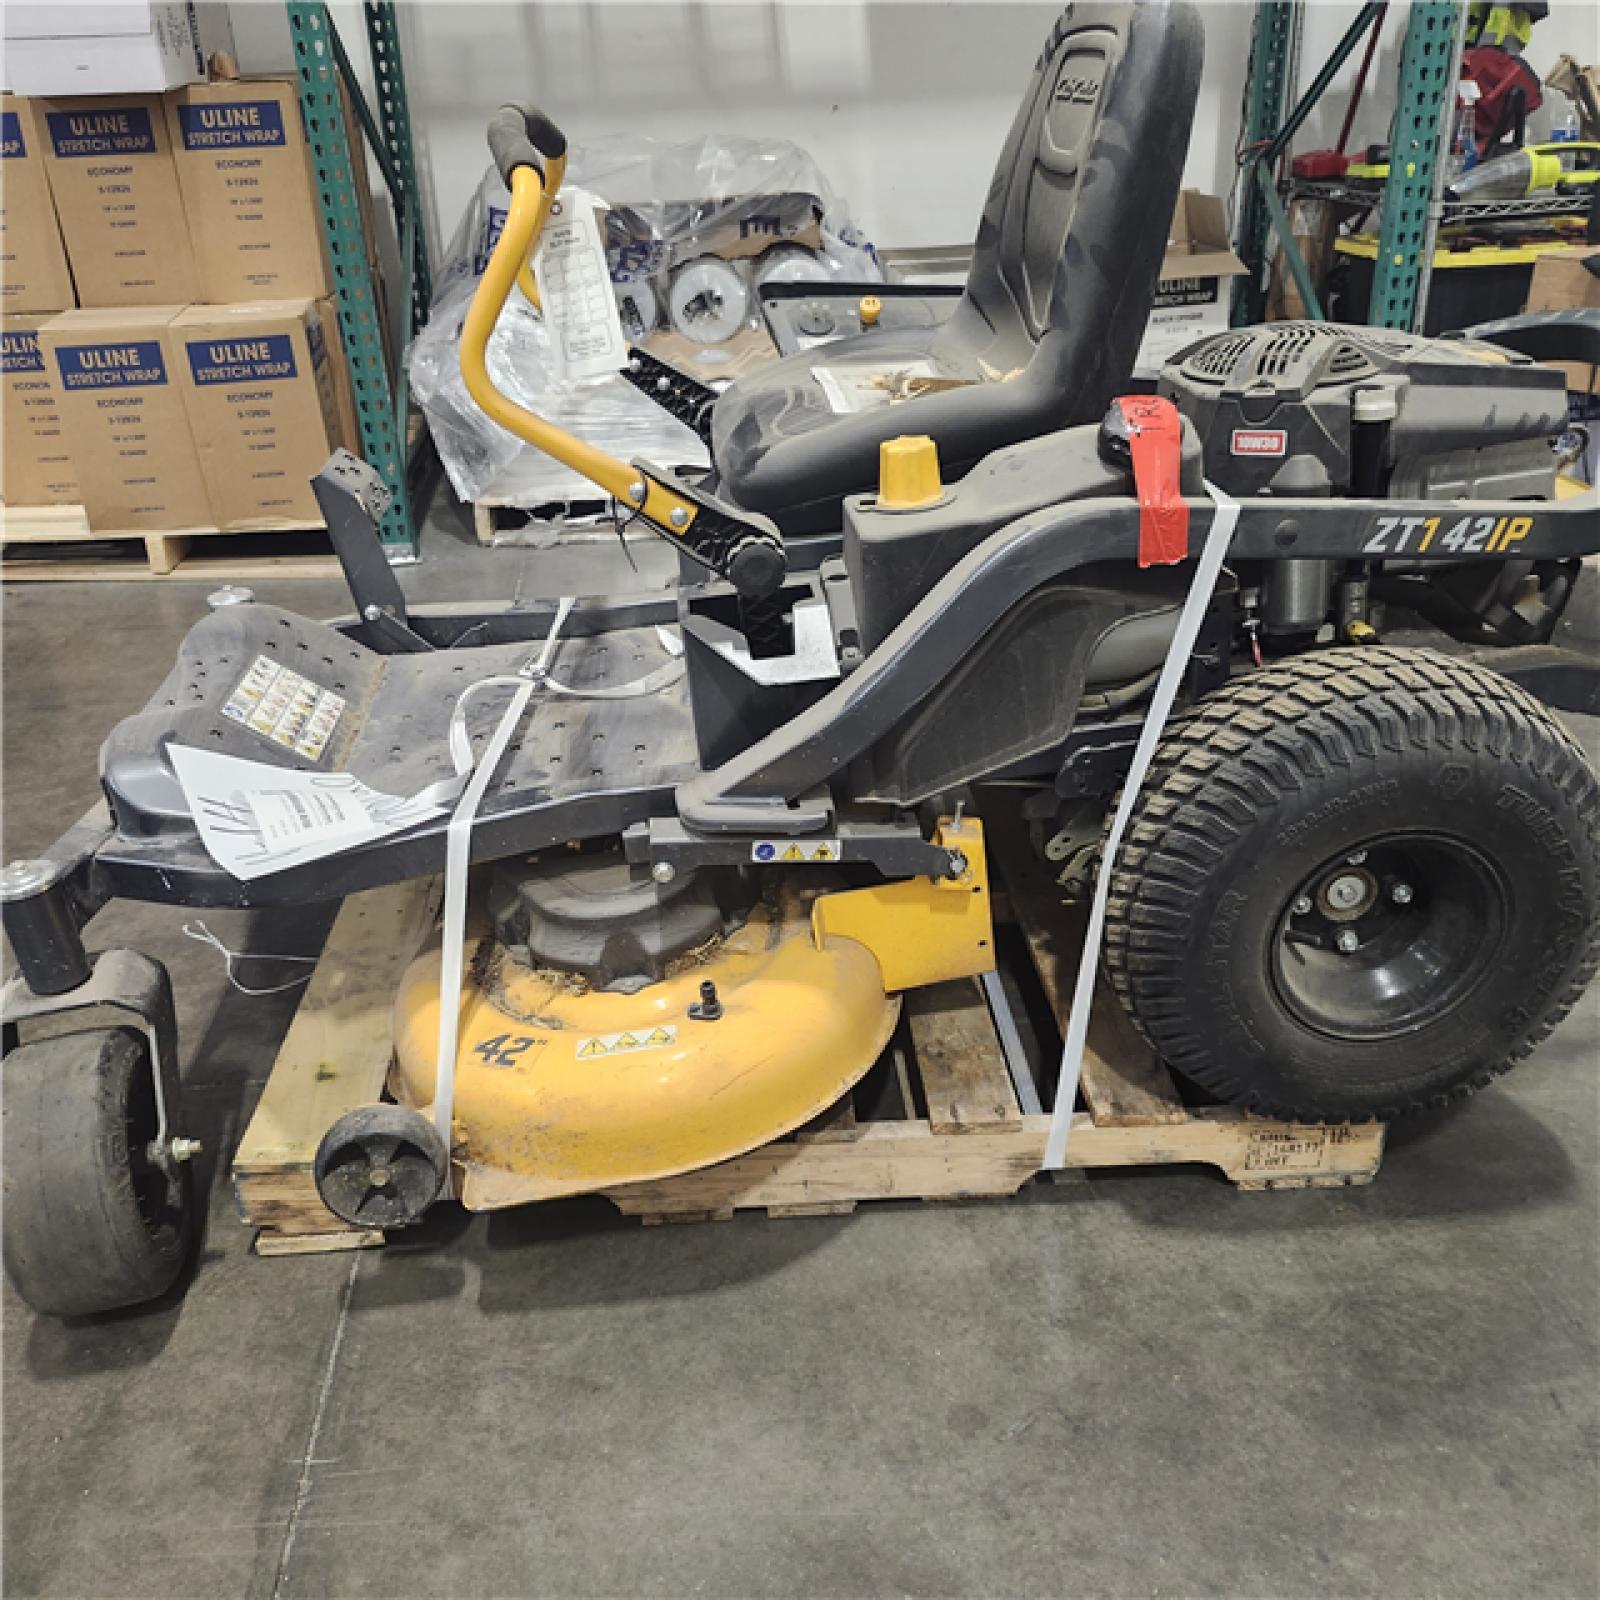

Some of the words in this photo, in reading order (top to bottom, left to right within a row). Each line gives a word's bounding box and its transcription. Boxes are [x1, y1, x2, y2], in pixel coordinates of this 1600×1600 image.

[69, 114, 129, 136] ULINE
[199, 107, 260, 128] ULINE
[57, 138, 111, 153] STRETCH
[113, 135, 150, 150] WRAP
[187, 131, 241, 145] STRETCH
[243, 129, 280, 143] WRAP
[87, 165, 133, 177] ECONOMY
[215, 159, 263, 170] ECONOMY
[79, 348, 140, 369] ULINE
[209, 341, 270, 364] ULINE
[66, 371, 121, 386] STRETCH
[123, 368, 161, 382] WRAP
[197, 364, 252, 381] STRETCH
[254, 361, 291, 376] WRAP
[96, 396, 143, 408] ECONOMY
[226, 390, 273, 403] ECONOMY
[1362, 516, 1442, 554] ZT1
